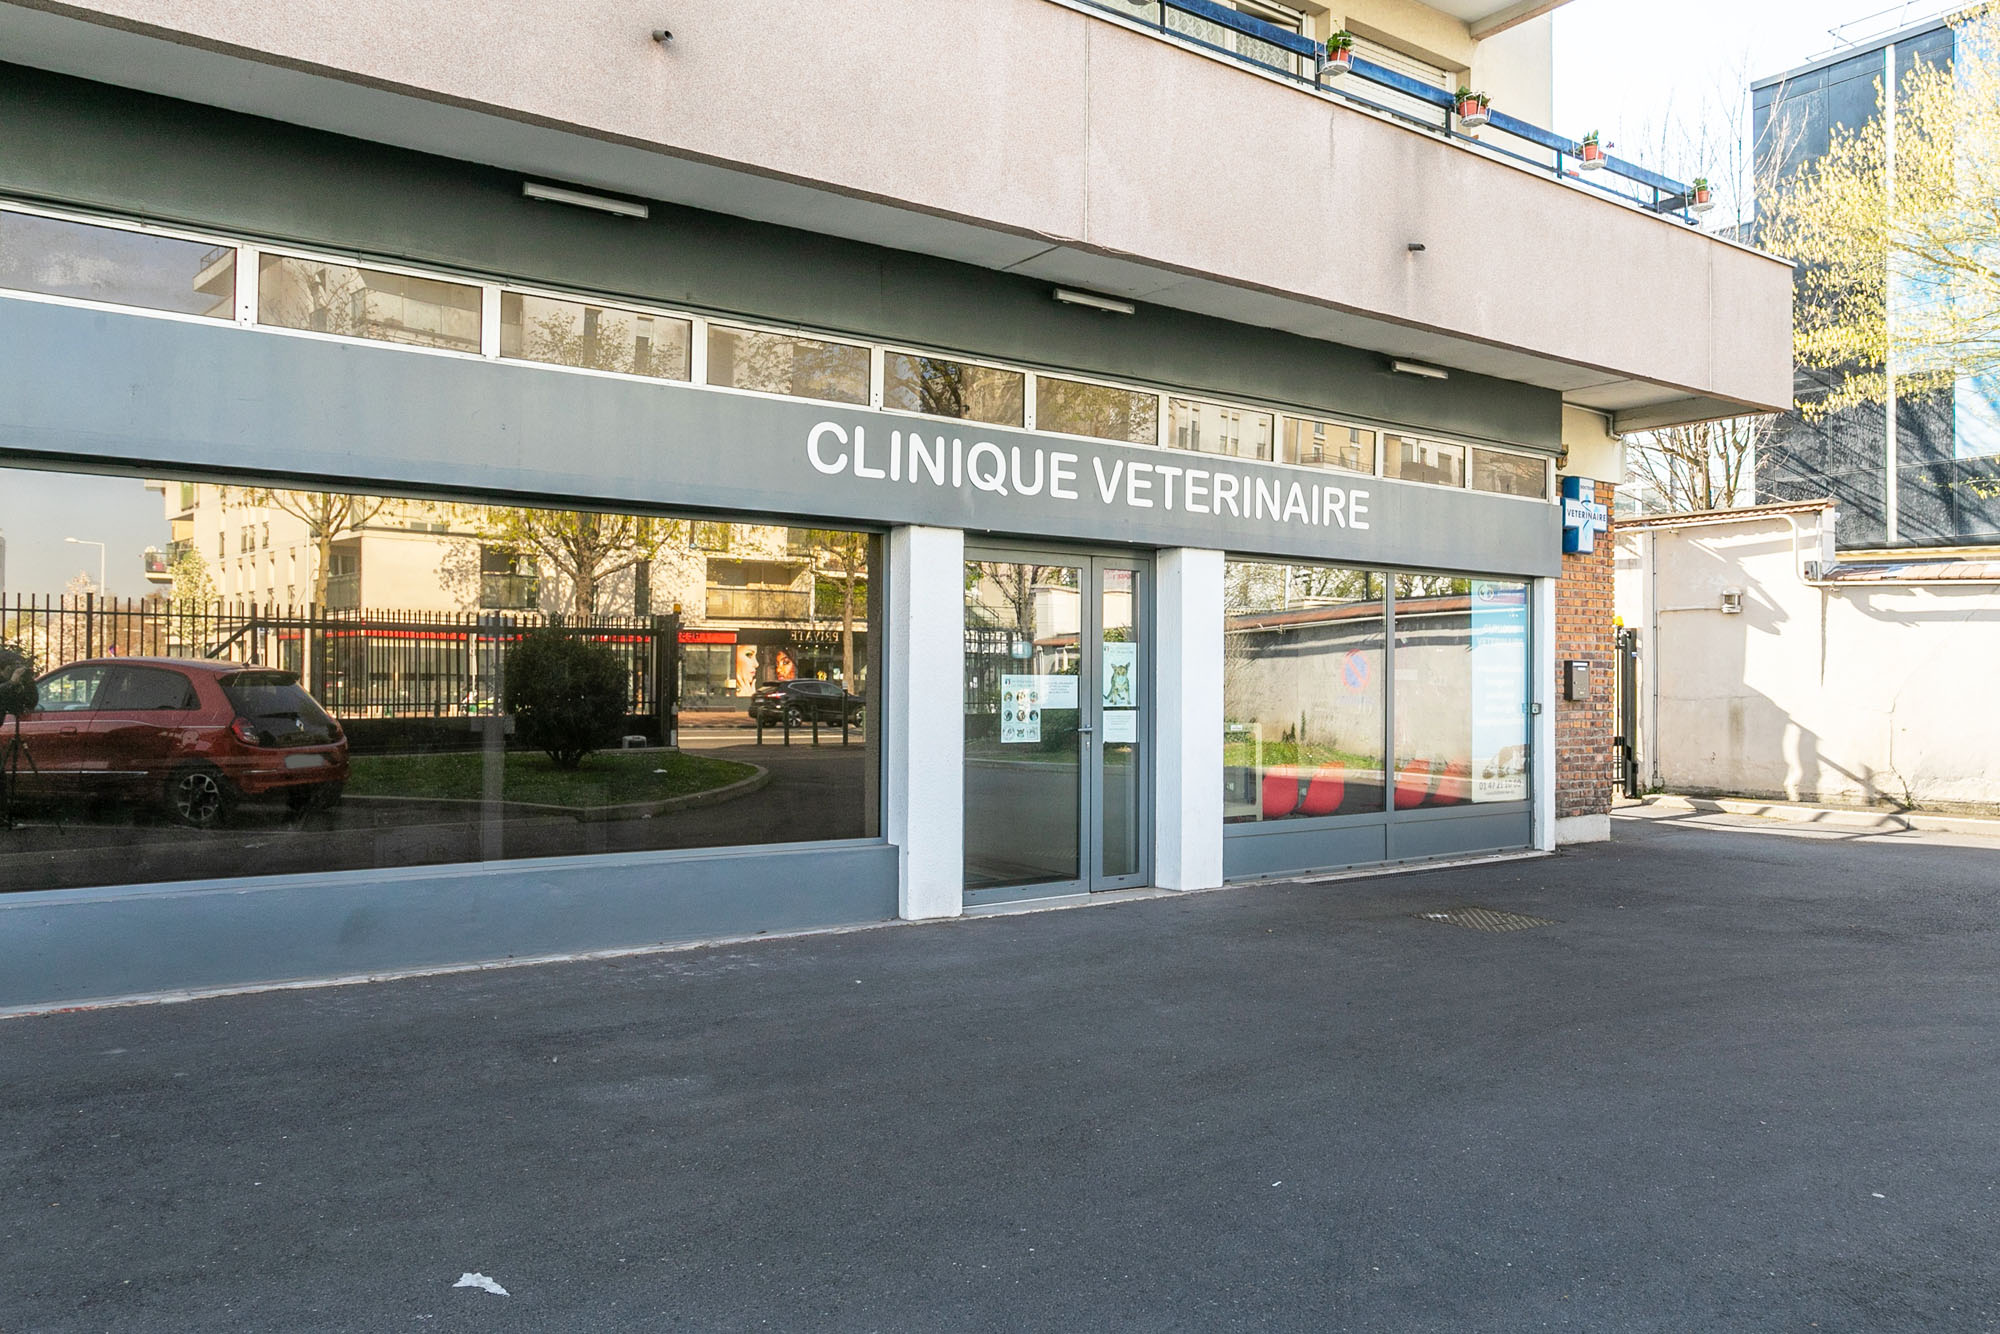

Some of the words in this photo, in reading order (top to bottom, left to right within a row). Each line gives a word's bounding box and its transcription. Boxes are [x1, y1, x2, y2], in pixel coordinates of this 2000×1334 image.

[806, 421, 1078, 499] CLINIQUE
[1093, 456, 1370, 530] VETERINAIRE
[1567, 509, 1606, 522] VETERINAIRE
